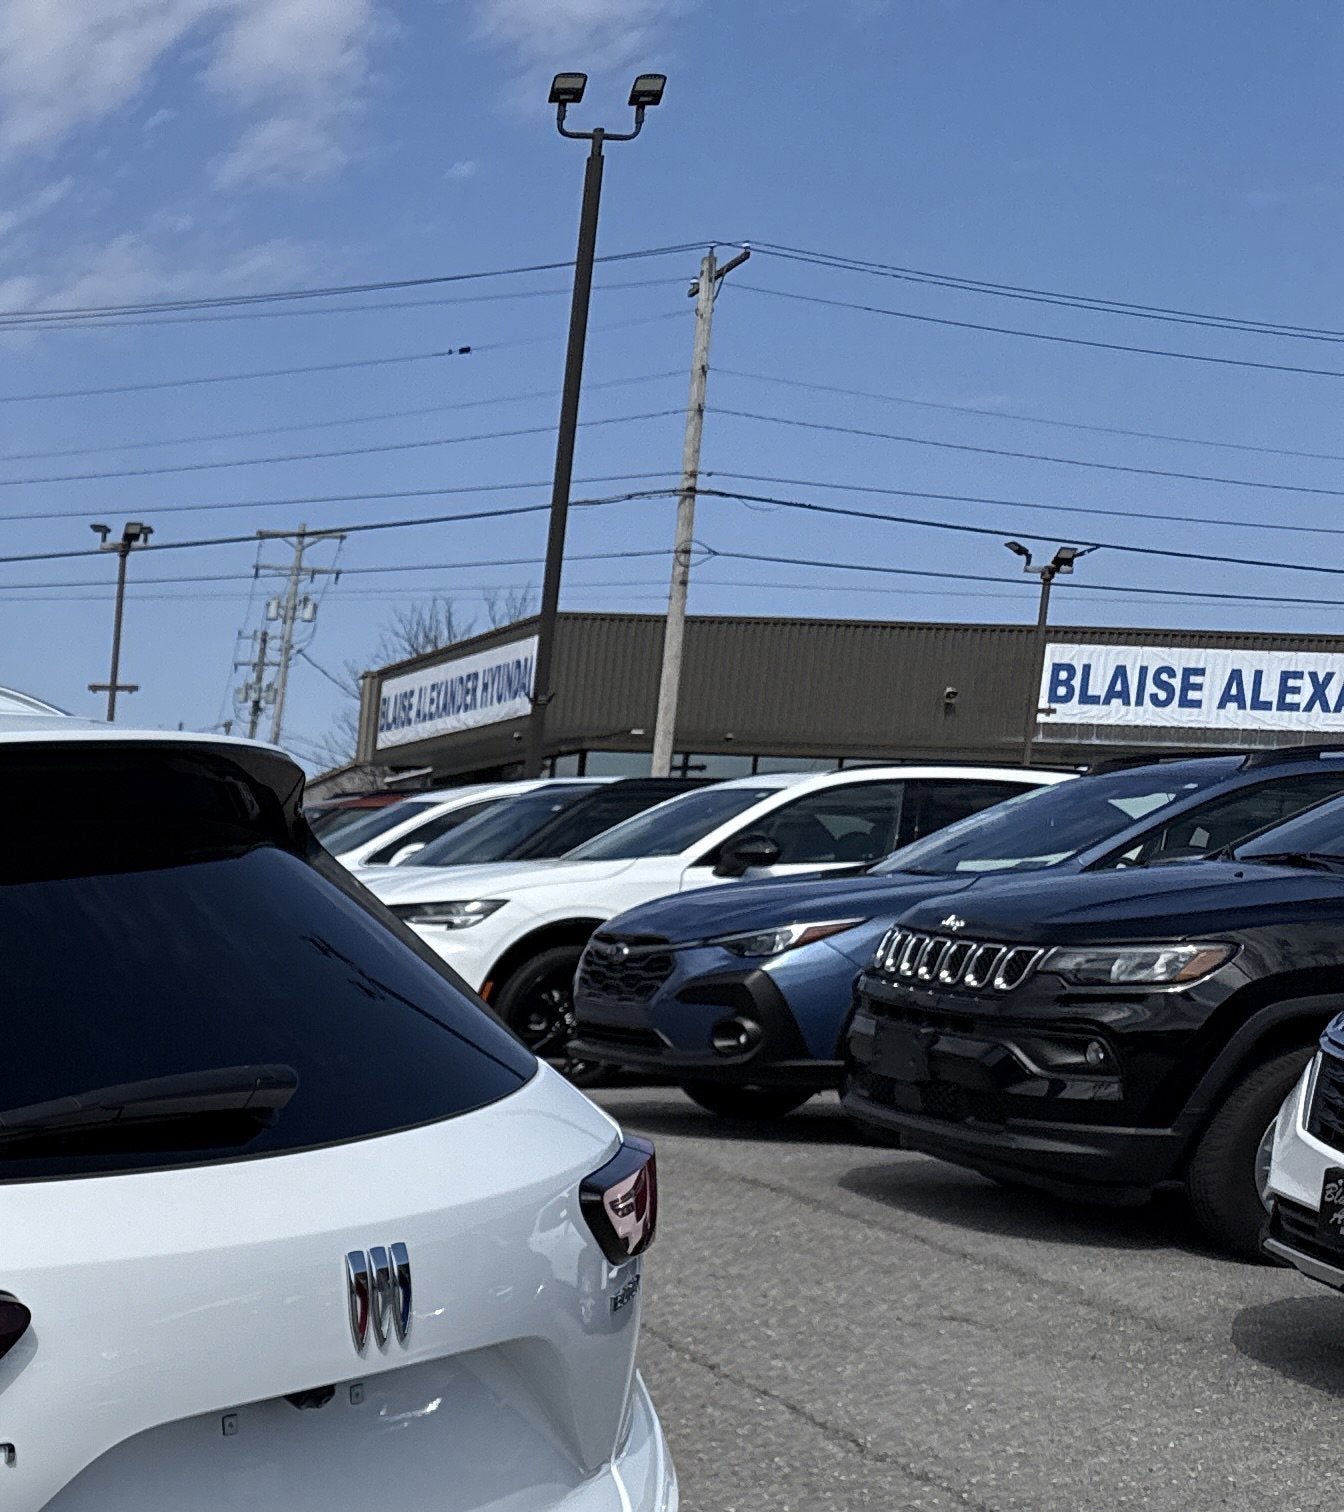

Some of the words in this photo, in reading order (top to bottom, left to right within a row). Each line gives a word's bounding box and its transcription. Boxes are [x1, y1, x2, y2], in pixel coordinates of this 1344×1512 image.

[379, 688, 414, 732] BLAISE
[413, 671, 479, 725] ALEXANDER
[480, 655, 533, 709] HYUNDAI
[1047, 662, 1206, 710] BLAISE
